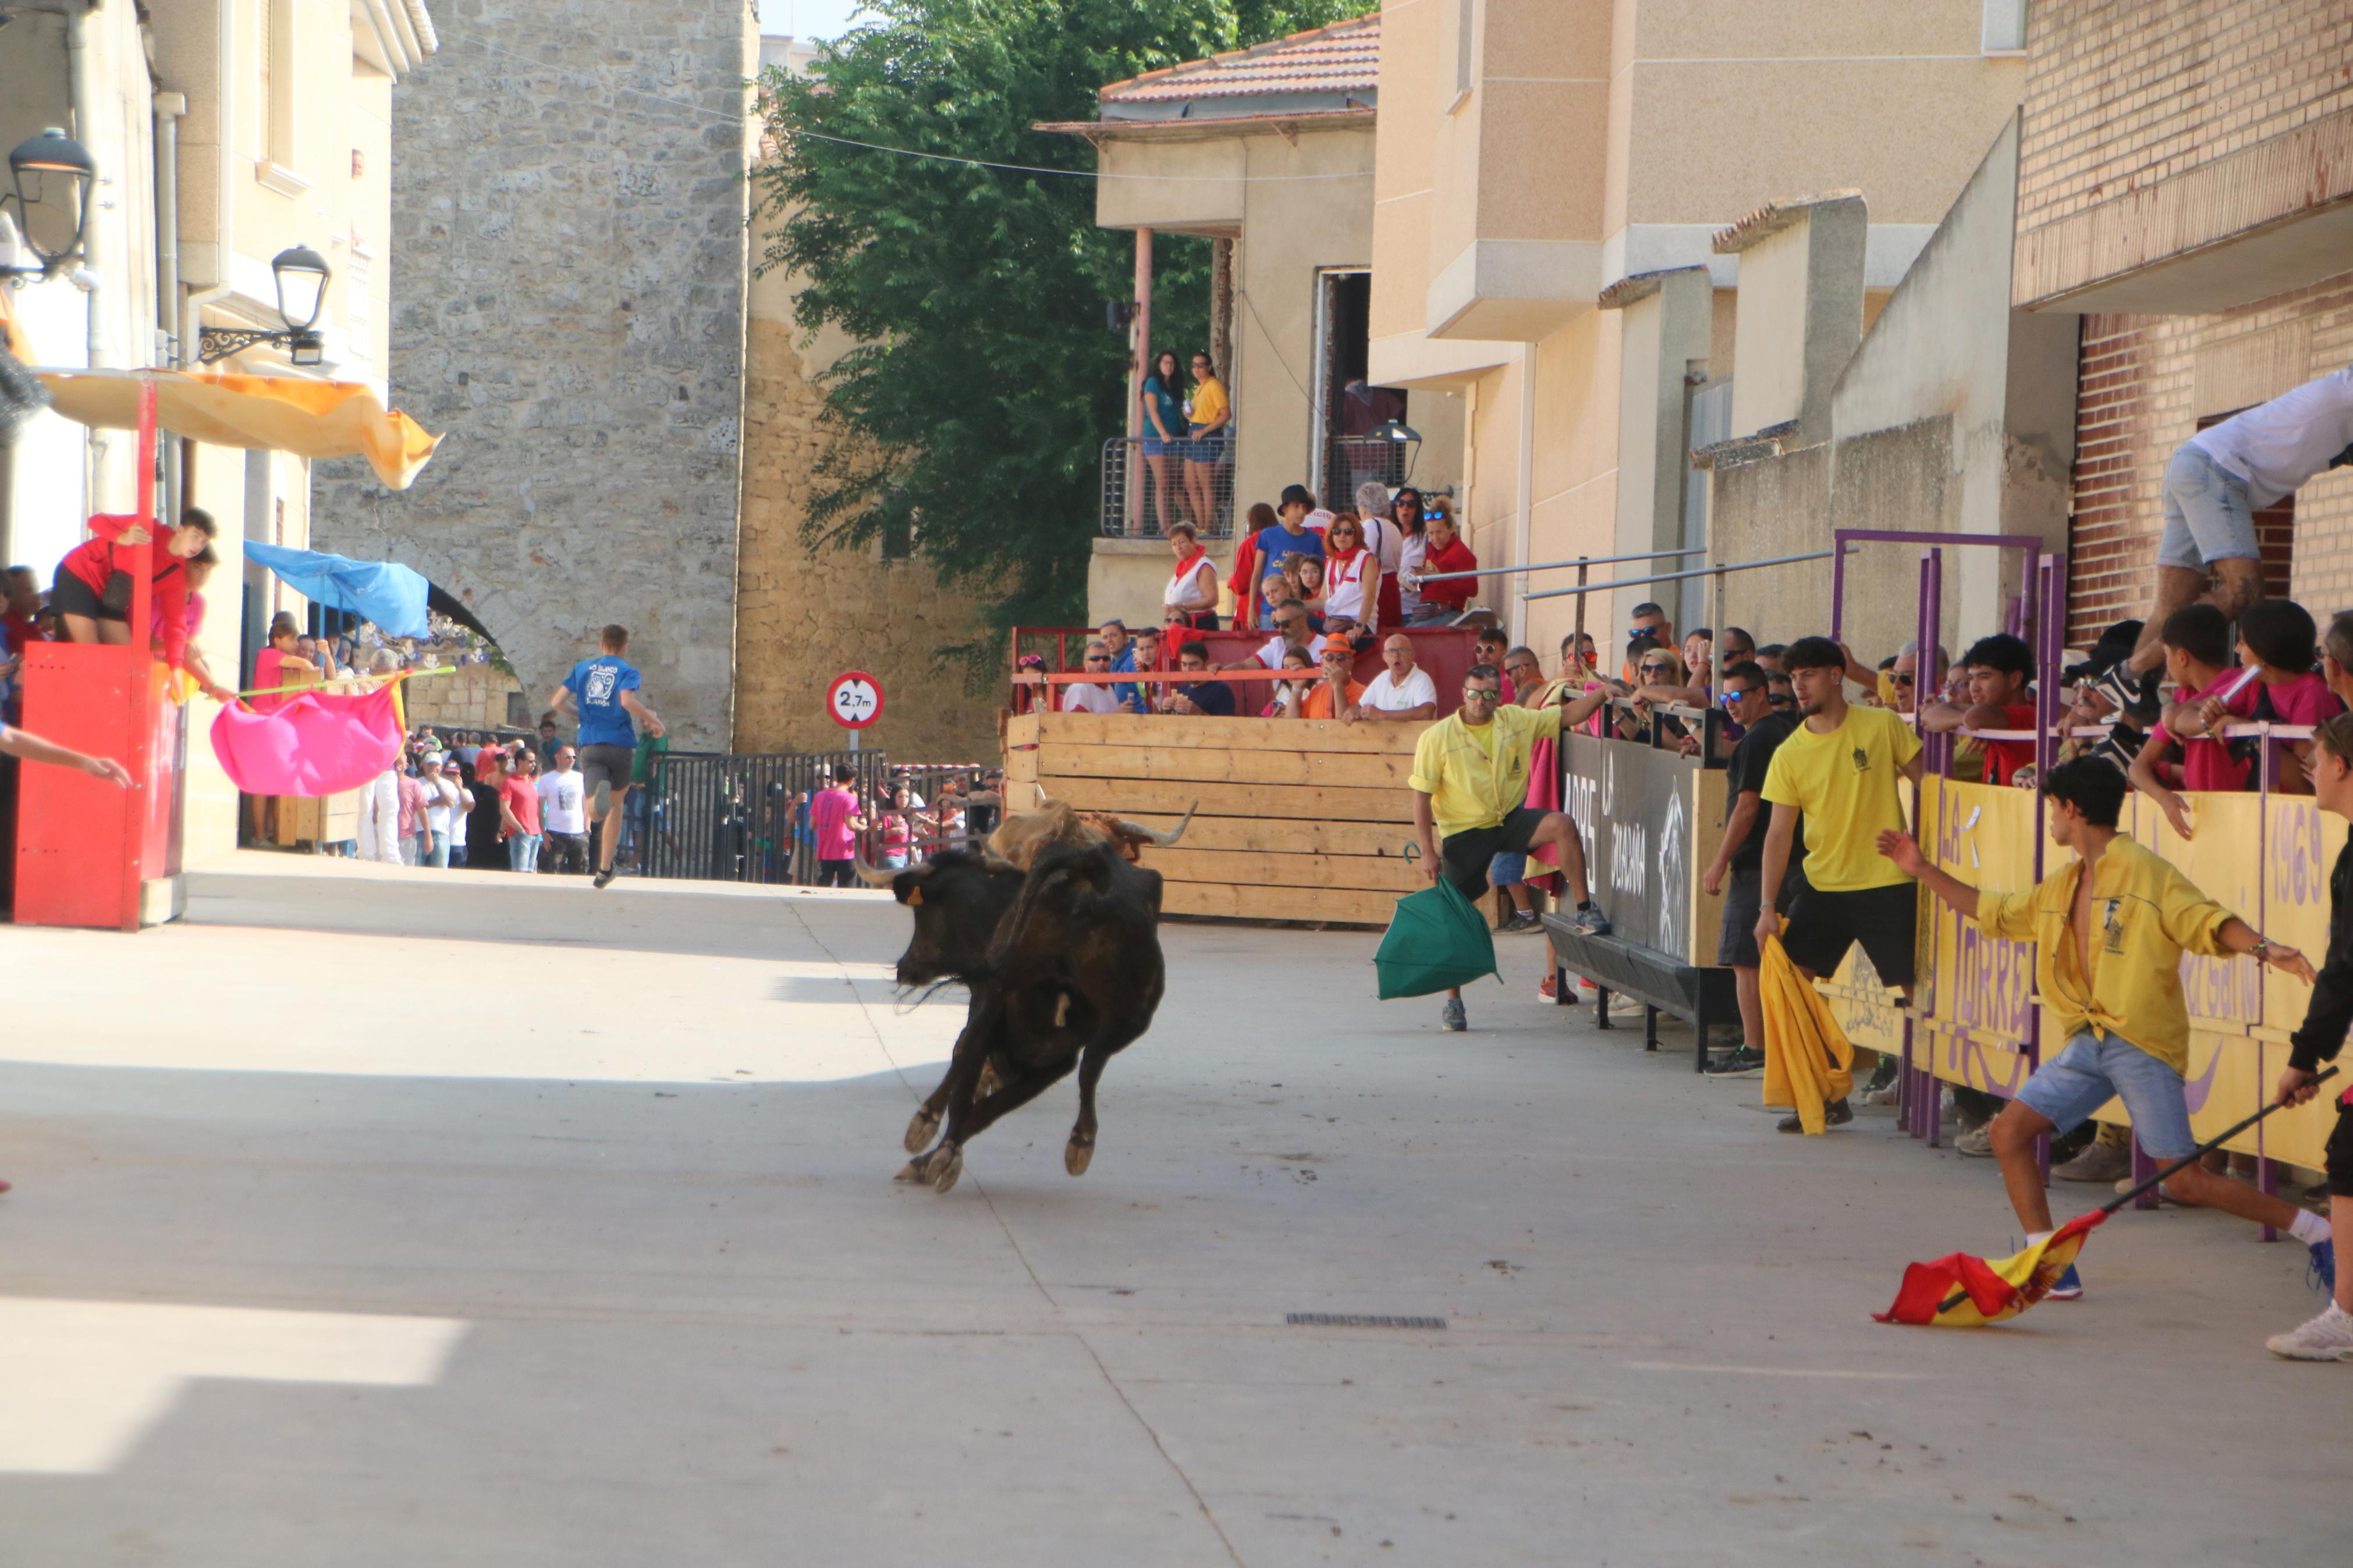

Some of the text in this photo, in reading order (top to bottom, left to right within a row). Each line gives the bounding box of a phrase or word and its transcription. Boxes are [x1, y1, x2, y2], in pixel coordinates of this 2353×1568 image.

[1602, 746, 1614, 816] LA
[1941, 788, 1962, 866] LA
[2272, 802, 2323, 906] 1969
[1945, 890, 2032, 1069] TORRE
